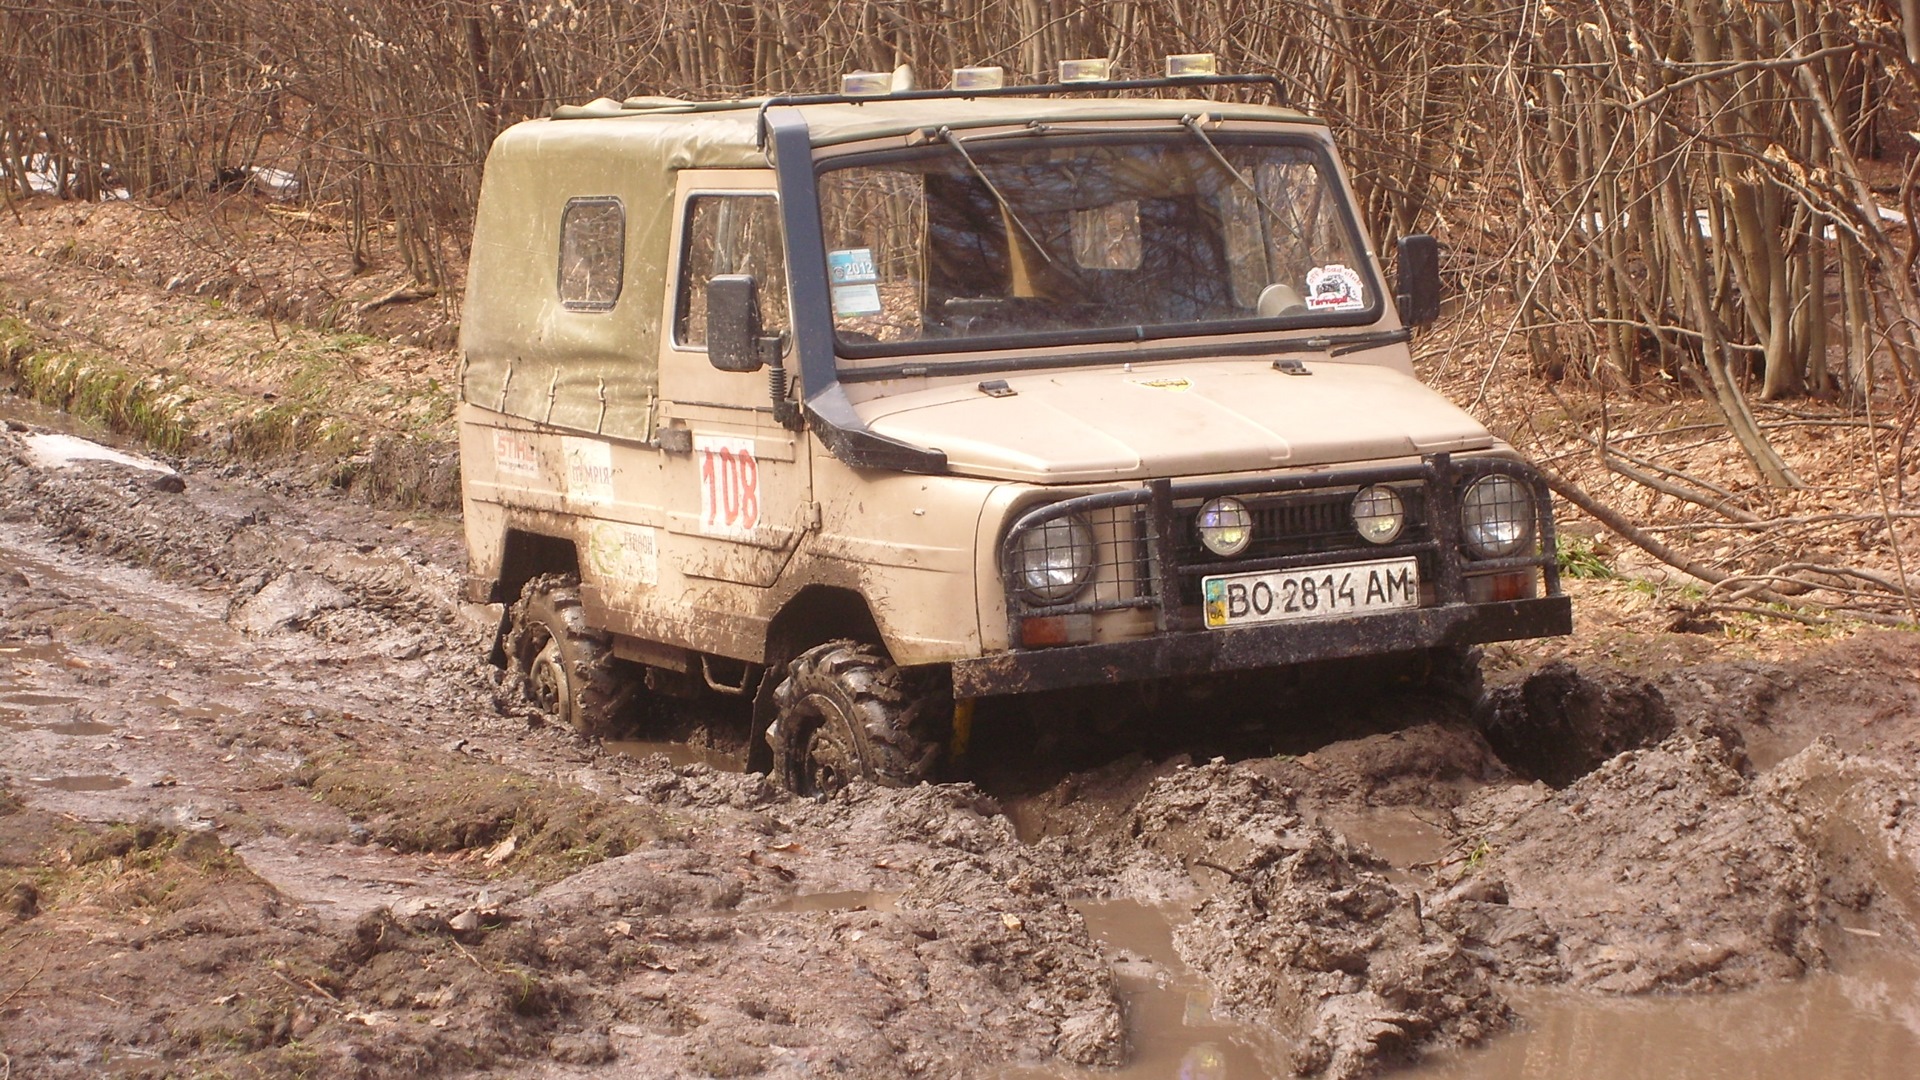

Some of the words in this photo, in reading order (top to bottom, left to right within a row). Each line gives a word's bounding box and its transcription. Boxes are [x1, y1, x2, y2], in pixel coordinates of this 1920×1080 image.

[845, 261, 874, 275] 2012
[703, 446, 758, 530] 108
[1227, 581, 1273, 618] BO
[1282, 573, 1355, 613] 2814
[1365, 567, 1409, 605] AM
